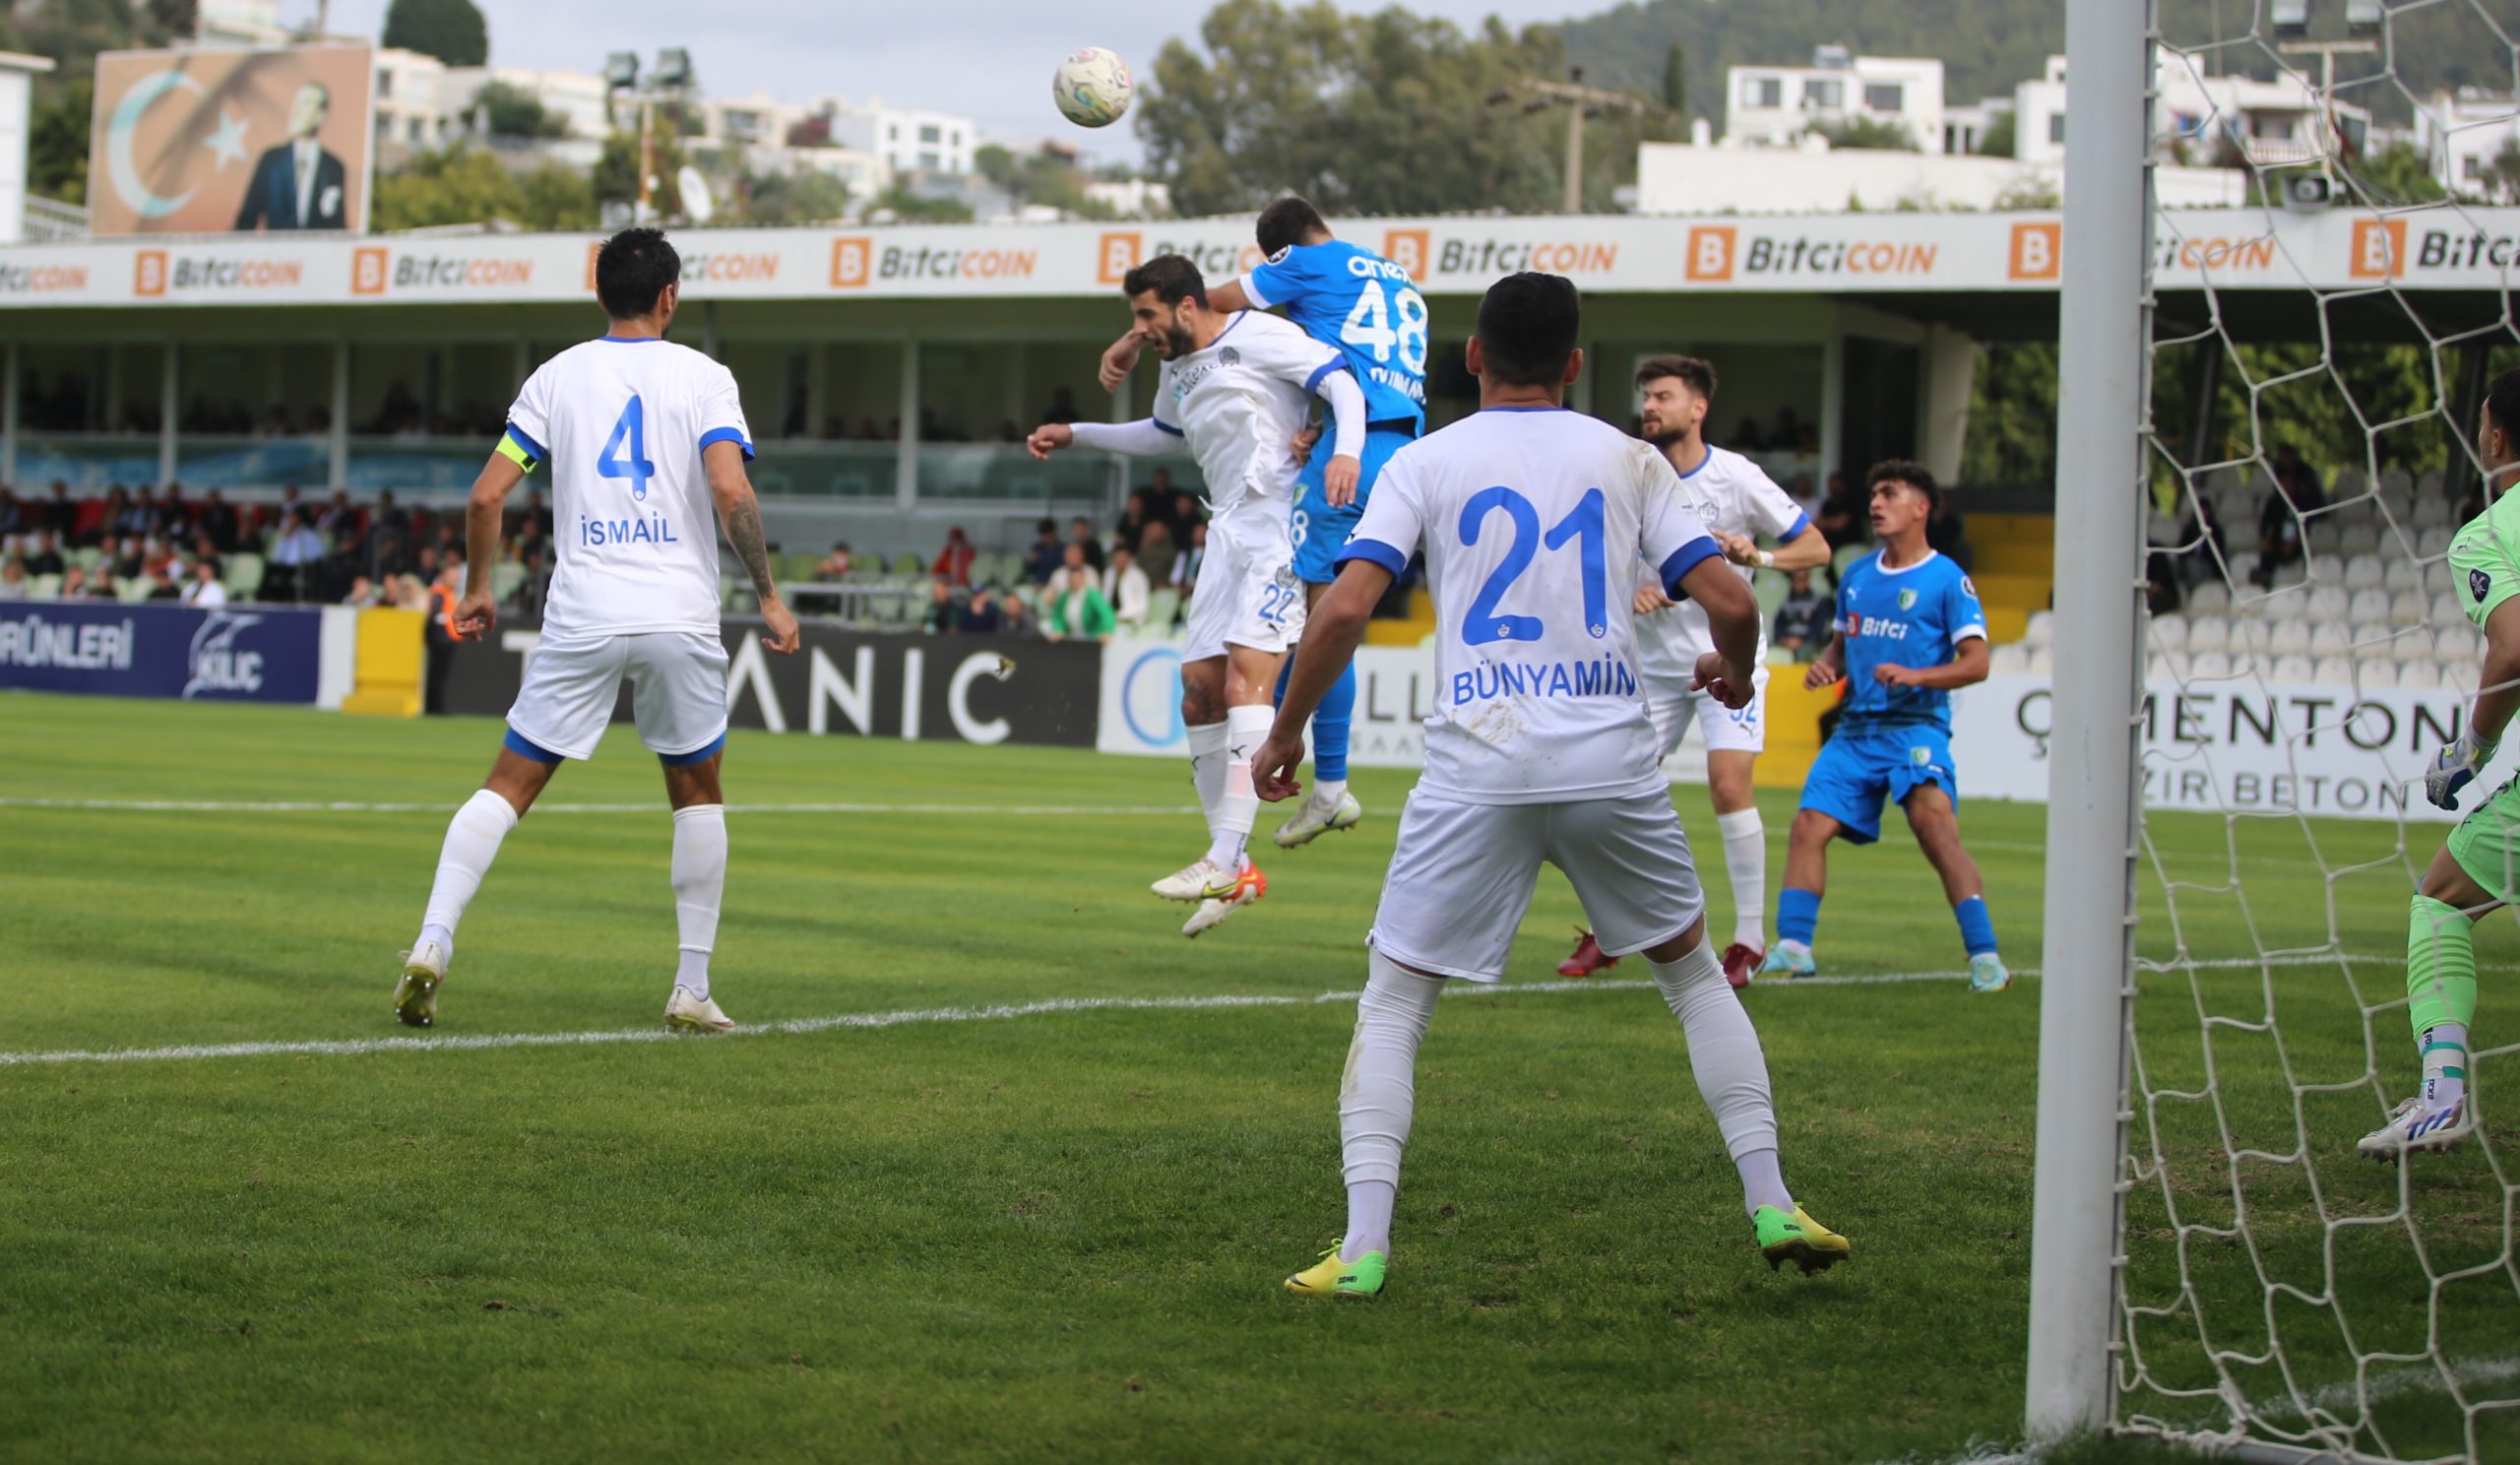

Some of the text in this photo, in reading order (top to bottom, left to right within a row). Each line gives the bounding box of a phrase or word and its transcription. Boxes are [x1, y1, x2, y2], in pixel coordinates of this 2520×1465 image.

[1745, 235, 1938, 274] BitciCOIN
[1340, 279, 1429, 377] 48
[597, 394, 655, 502] 4
[581, 510, 678, 547] İSMAİL
[1458, 485, 1608, 646] 21
[1259, 583, 1295, 623] 22
[1861, 615, 1908, 641] Bitci
[1453, 651, 1636, 706] BÜNYAMİN
[2235, 775, 2408, 812] BETON
